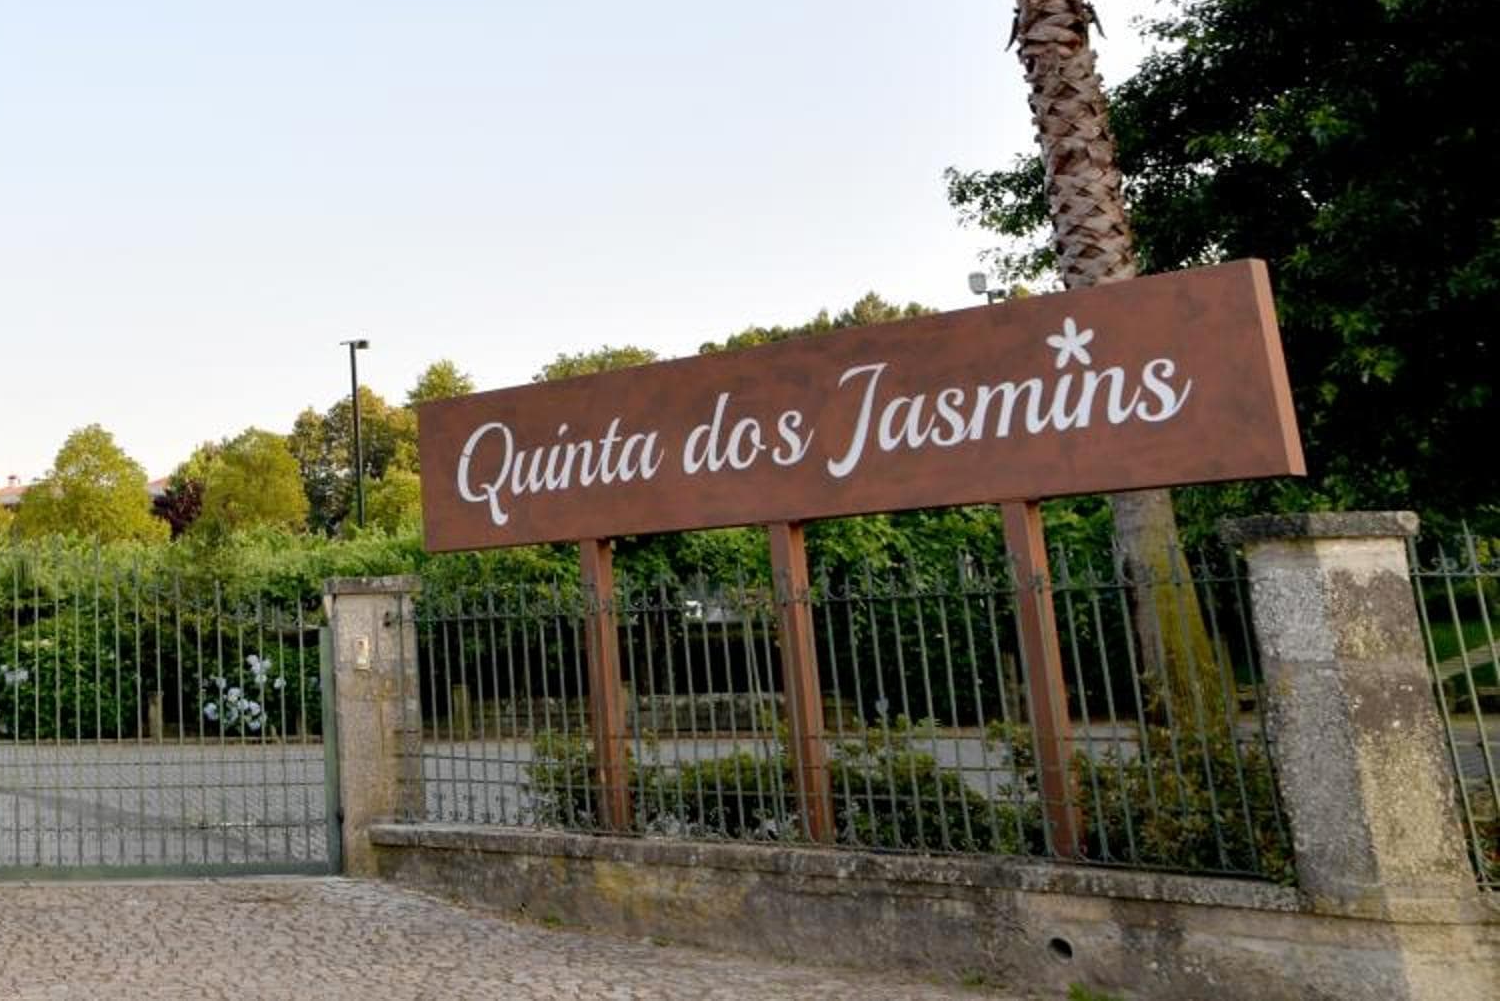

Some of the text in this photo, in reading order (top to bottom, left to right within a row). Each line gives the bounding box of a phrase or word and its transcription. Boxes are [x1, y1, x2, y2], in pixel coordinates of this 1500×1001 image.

[457, 317, 1193, 526] Quinta dos Jasmins
